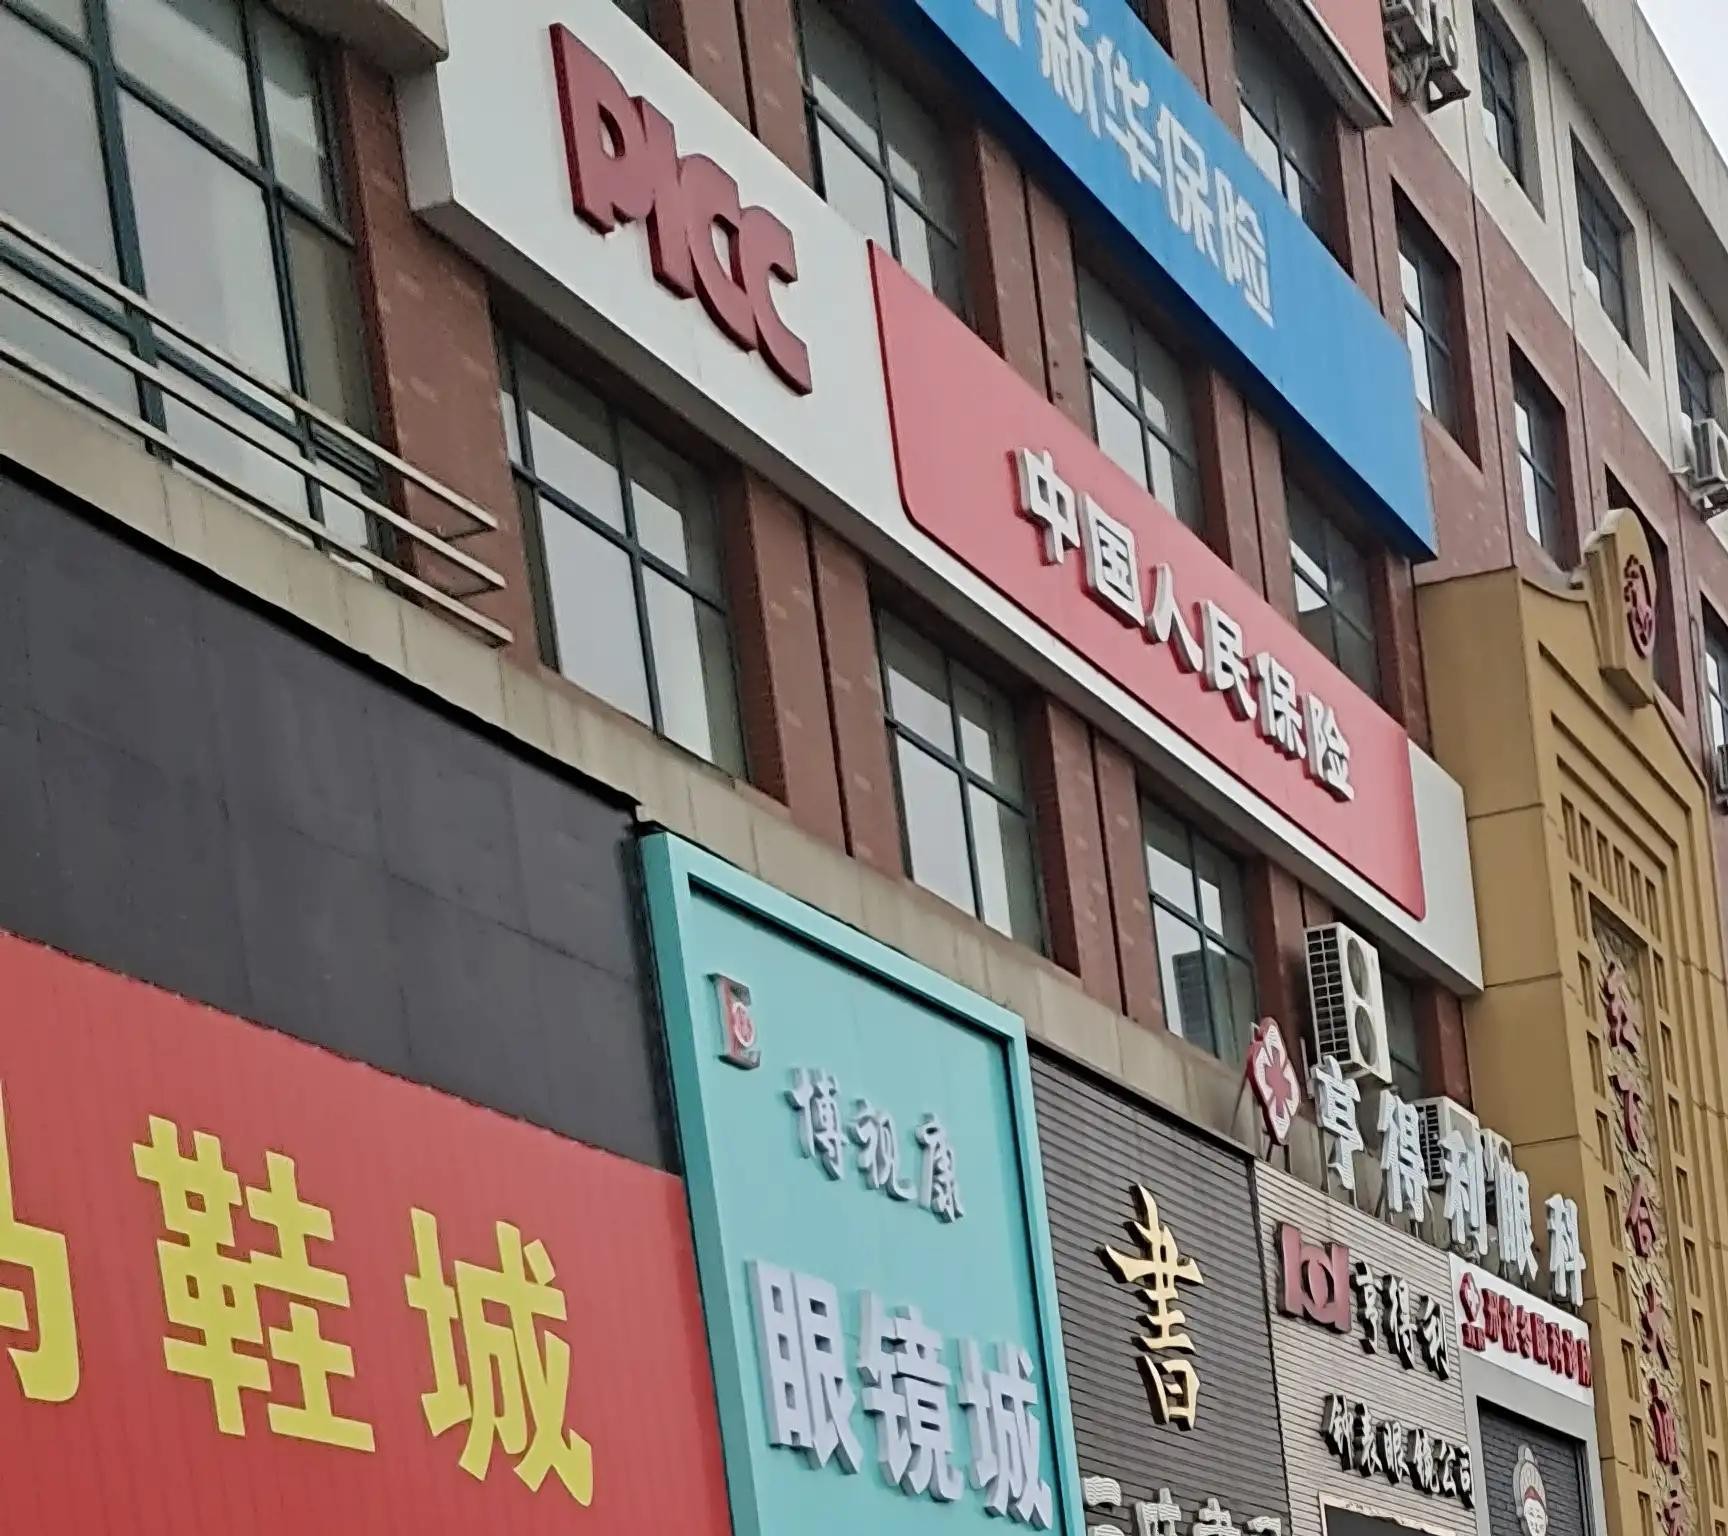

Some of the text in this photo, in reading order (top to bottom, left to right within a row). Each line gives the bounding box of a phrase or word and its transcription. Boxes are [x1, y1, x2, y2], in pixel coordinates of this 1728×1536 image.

[550, 23, 812, 395] PICC
[1035, 0, 1274, 328] 新华保险
[1010, 446, 1355, 801] 中国人民保险
[746, 1258, 1053, 1530] 眼镜城
[1320, 1393, 1476, 1510] 钟表眼镜公司
